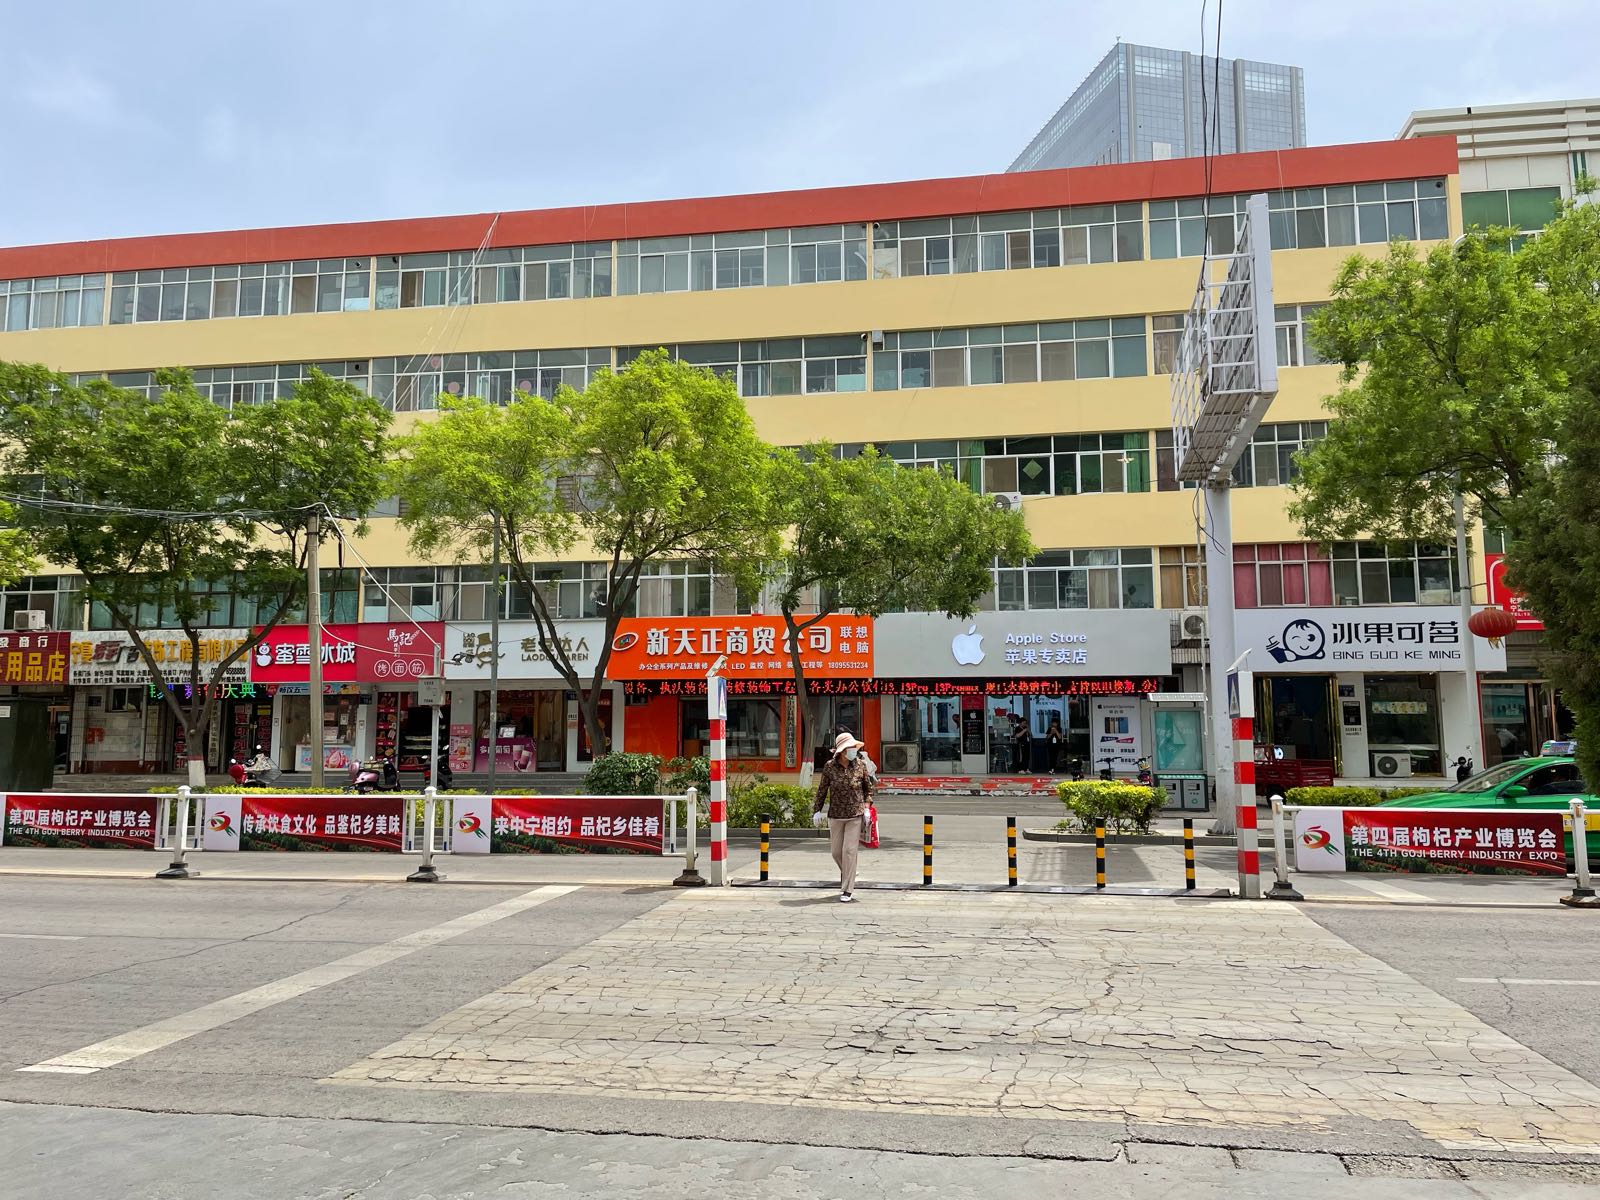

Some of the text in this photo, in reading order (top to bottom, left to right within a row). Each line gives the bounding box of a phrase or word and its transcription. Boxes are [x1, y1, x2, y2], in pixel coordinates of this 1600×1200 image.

[839, 626, 868, 638] 联想
[1005, 633, 1087, 646] Apple Store
[1332, 621, 1459, 644] 冰果可茗
[646, 626, 832, 655] 新天正商贸公司
[839, 641, 869, 654] 电脑
[1005, 648, 1088, 664] 苹果专卖店
[1333, 650, 1461, 660] BING GUO KE MING
[0, 652, 66, 682] 用品店
[731, 662, 746, 670] LED
[9, 808, 152, 827] 第四届枸杞产业博览会
[242, 814, 401, 835] 传承饮食文化 品鉴杞乡美味
[9, 827, 150, 837] THE 4TH GOJI BERRY INDUSTRY EXPO
[494, 816, 660, 837] 来中宁相约 品杞乡佳肴
[1350, 825, 1557, 848] 第四届枸杞产业博览会
[1352, 848, 1558, 860] THE 4TH GOJI BERRY INDUSTRY EXPO
